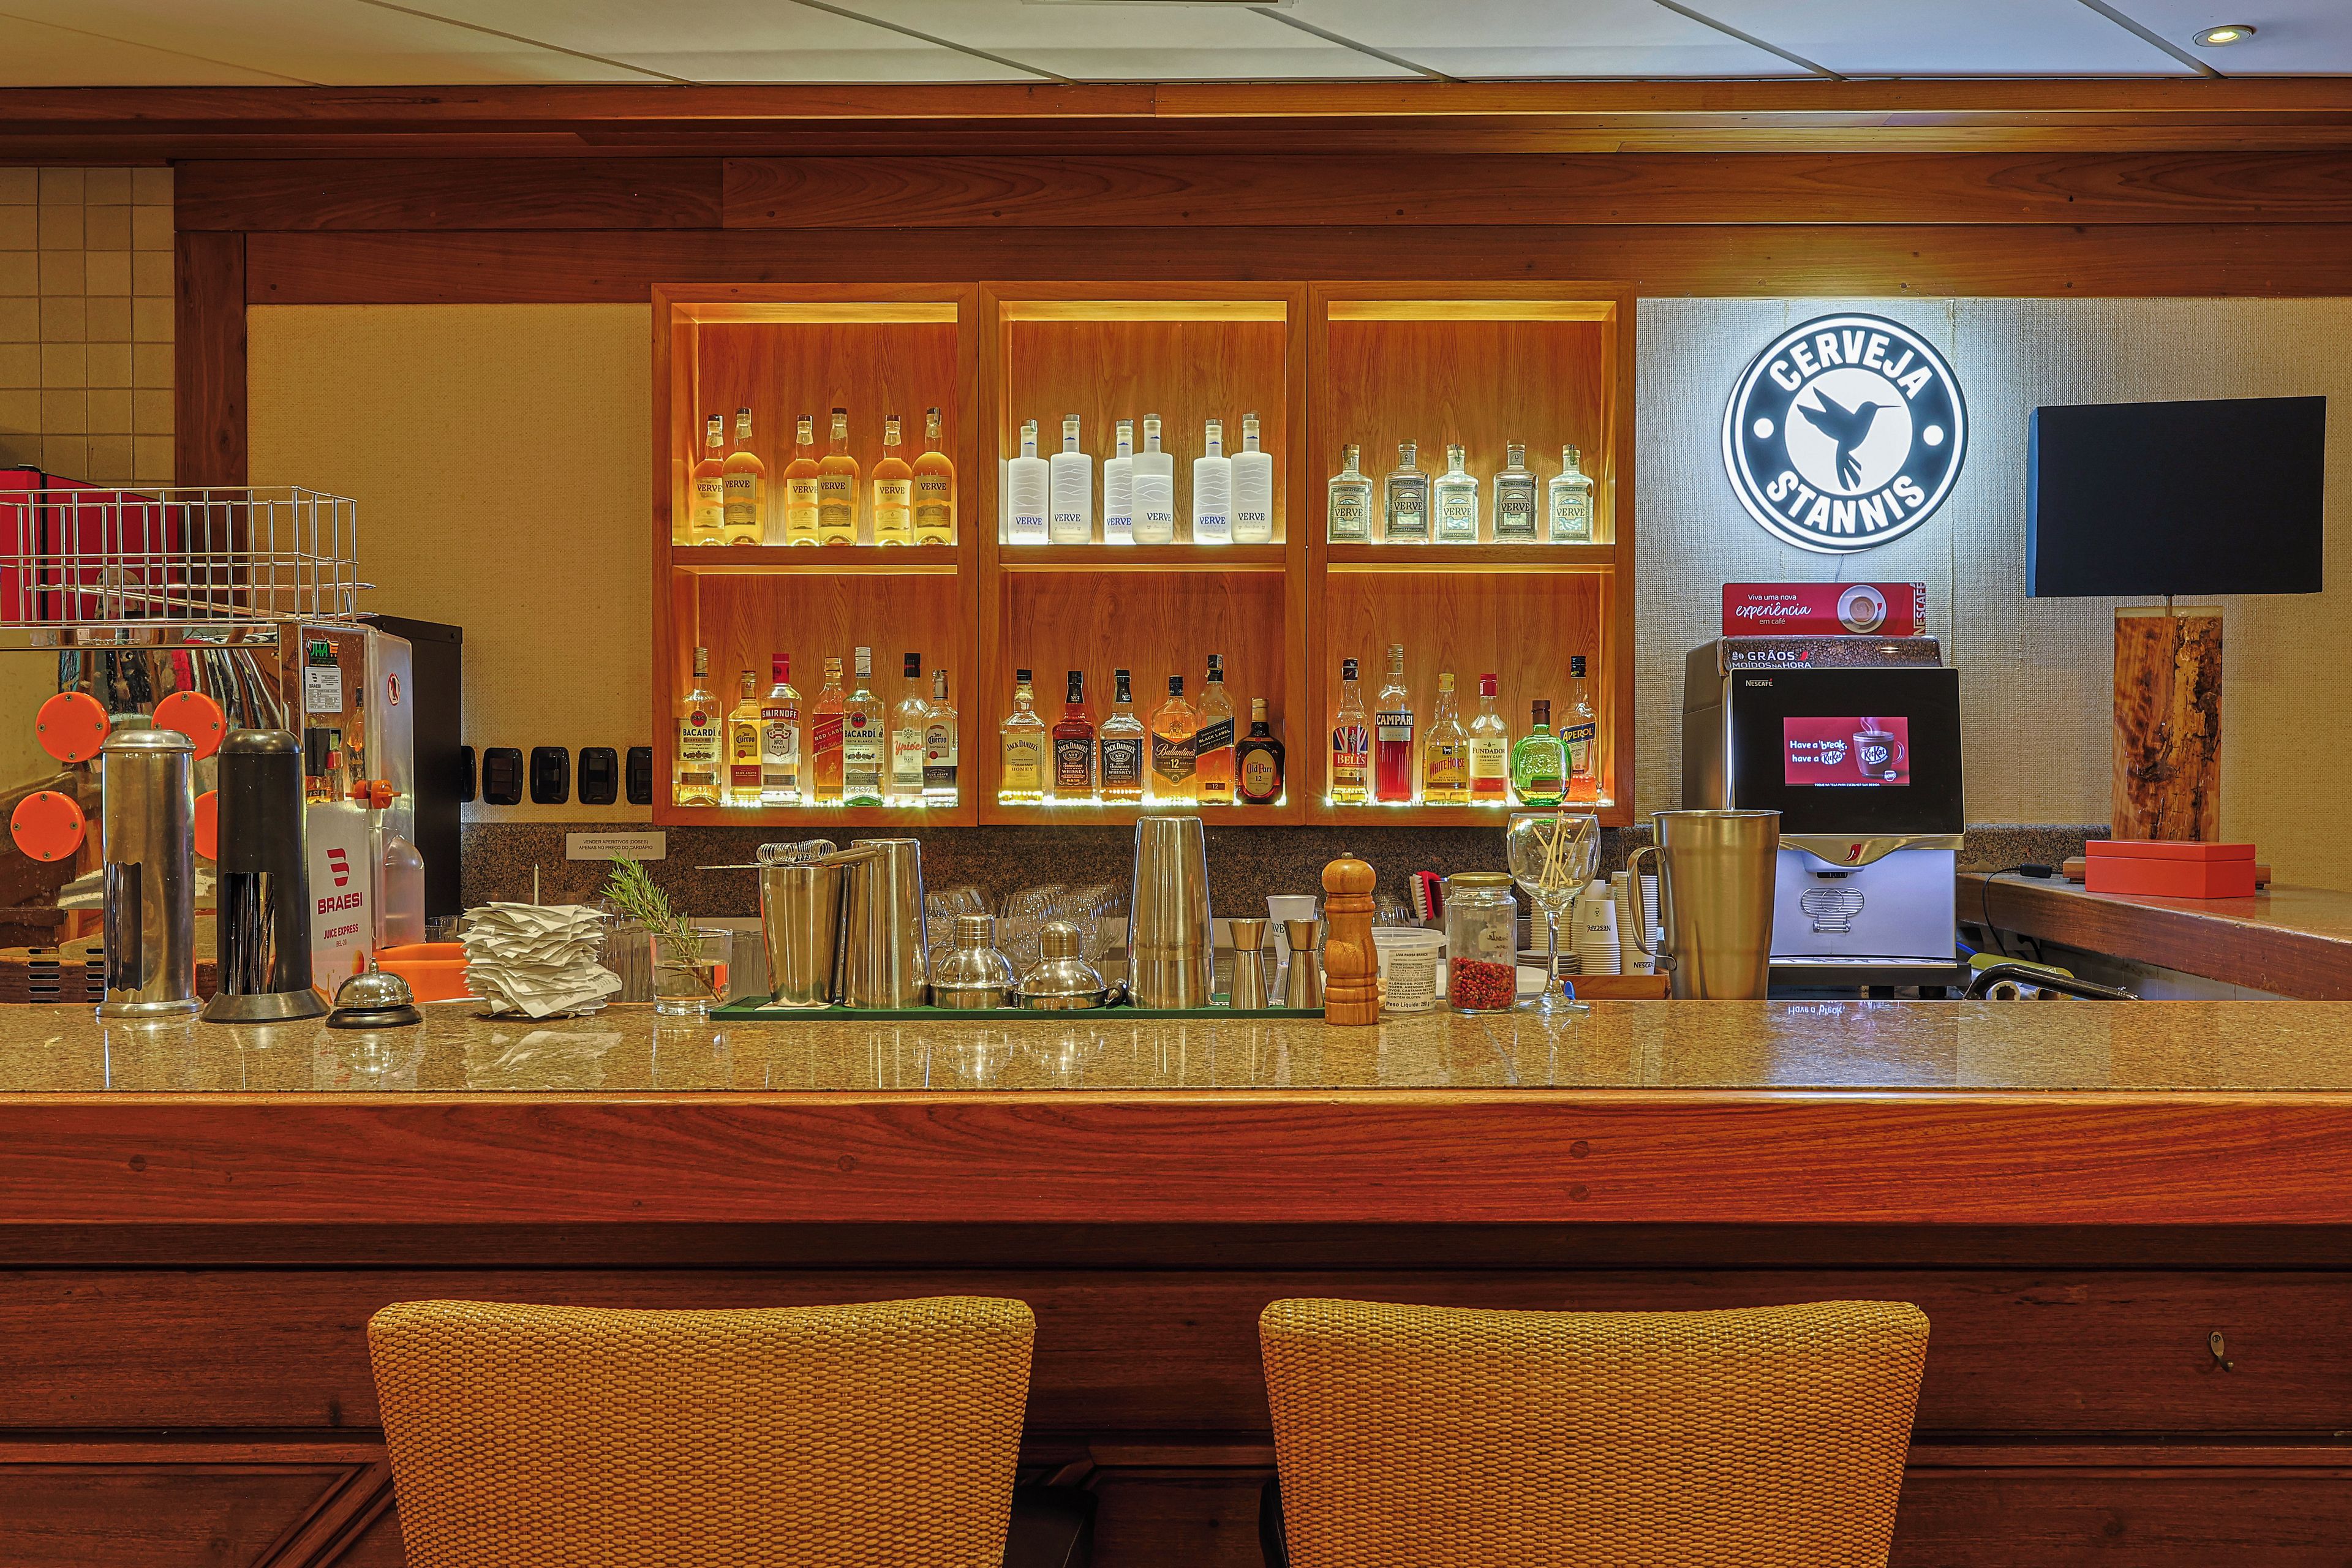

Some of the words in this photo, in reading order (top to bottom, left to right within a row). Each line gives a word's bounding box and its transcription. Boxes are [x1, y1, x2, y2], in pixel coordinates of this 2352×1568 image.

[1769, 330, 1933, 400] CERVEJA
[697, 484, 723, 492] VERVE
[725, 480, 750, 488] VERVE
[1393, 502, 1423, 511] VERVE
[1501, 502, 1531, 511] VERVE
[1766, 470, 1926, 534] STANNIS
[1238, 512, 1265, 521] VERVE
[1335, 508, 1363, 517] VERVE
[1443, 507, 1472, 516] VERVE
[1556, 507, 1585, 516] VERVE
[1016, 516, 1042, 526] VERVE
[1054, 513, 1081, 522] VERVE
[1107, 517, 1132, 526] VERVE
[1147, 512, 1172, 522] VERVE
[1199, 516, 1226, 525] VERVE
[1735, 602, 1812, 619] experiência
[1747, 649, 1795, 661] GRÃOS
[1376, 714, 1413, 725] CAMPARI
[683, 727, 715, 736] BACARDÍ
[827, 727, 843, 736] LABE
[845, 728, 876, 738] BACARDÍ
[1199, 734, 1215, 744] BLACK
[1215, 729, 1231, 737] LABEL
[1562, 728, 1593, 742] APEROL
[736, 735, 755, 744] Cuervo
[928, 736, 947, 744] Cuervo
[894, 741, 922, 756] Ypióc
[1006, 742, 1019, 752] JACK
[1057, 743, 1070, 753] JACK
[1104, 744, 1117, 754] JACK
[1790, 741, 1811, 749] Have
[1823, 751, 1843, 764] KitKat
[1863, 746, 1887, 761] KitKat
[1170, 758, 1180, 769] 12
[1337, 754, 1366, 764] BELL'S
[1246, 763, 1257, 774] Old
[1257, 763, 1272, 774] Parr
[1429, 759, 1447, 778] WHITE
[1447, 756, 1465, 770] HORSE
[317, 891, 363, 915] BRAESI
[323, 928, 337, 940] JUICE
[337, 923, 359, 937] EXPRESS
